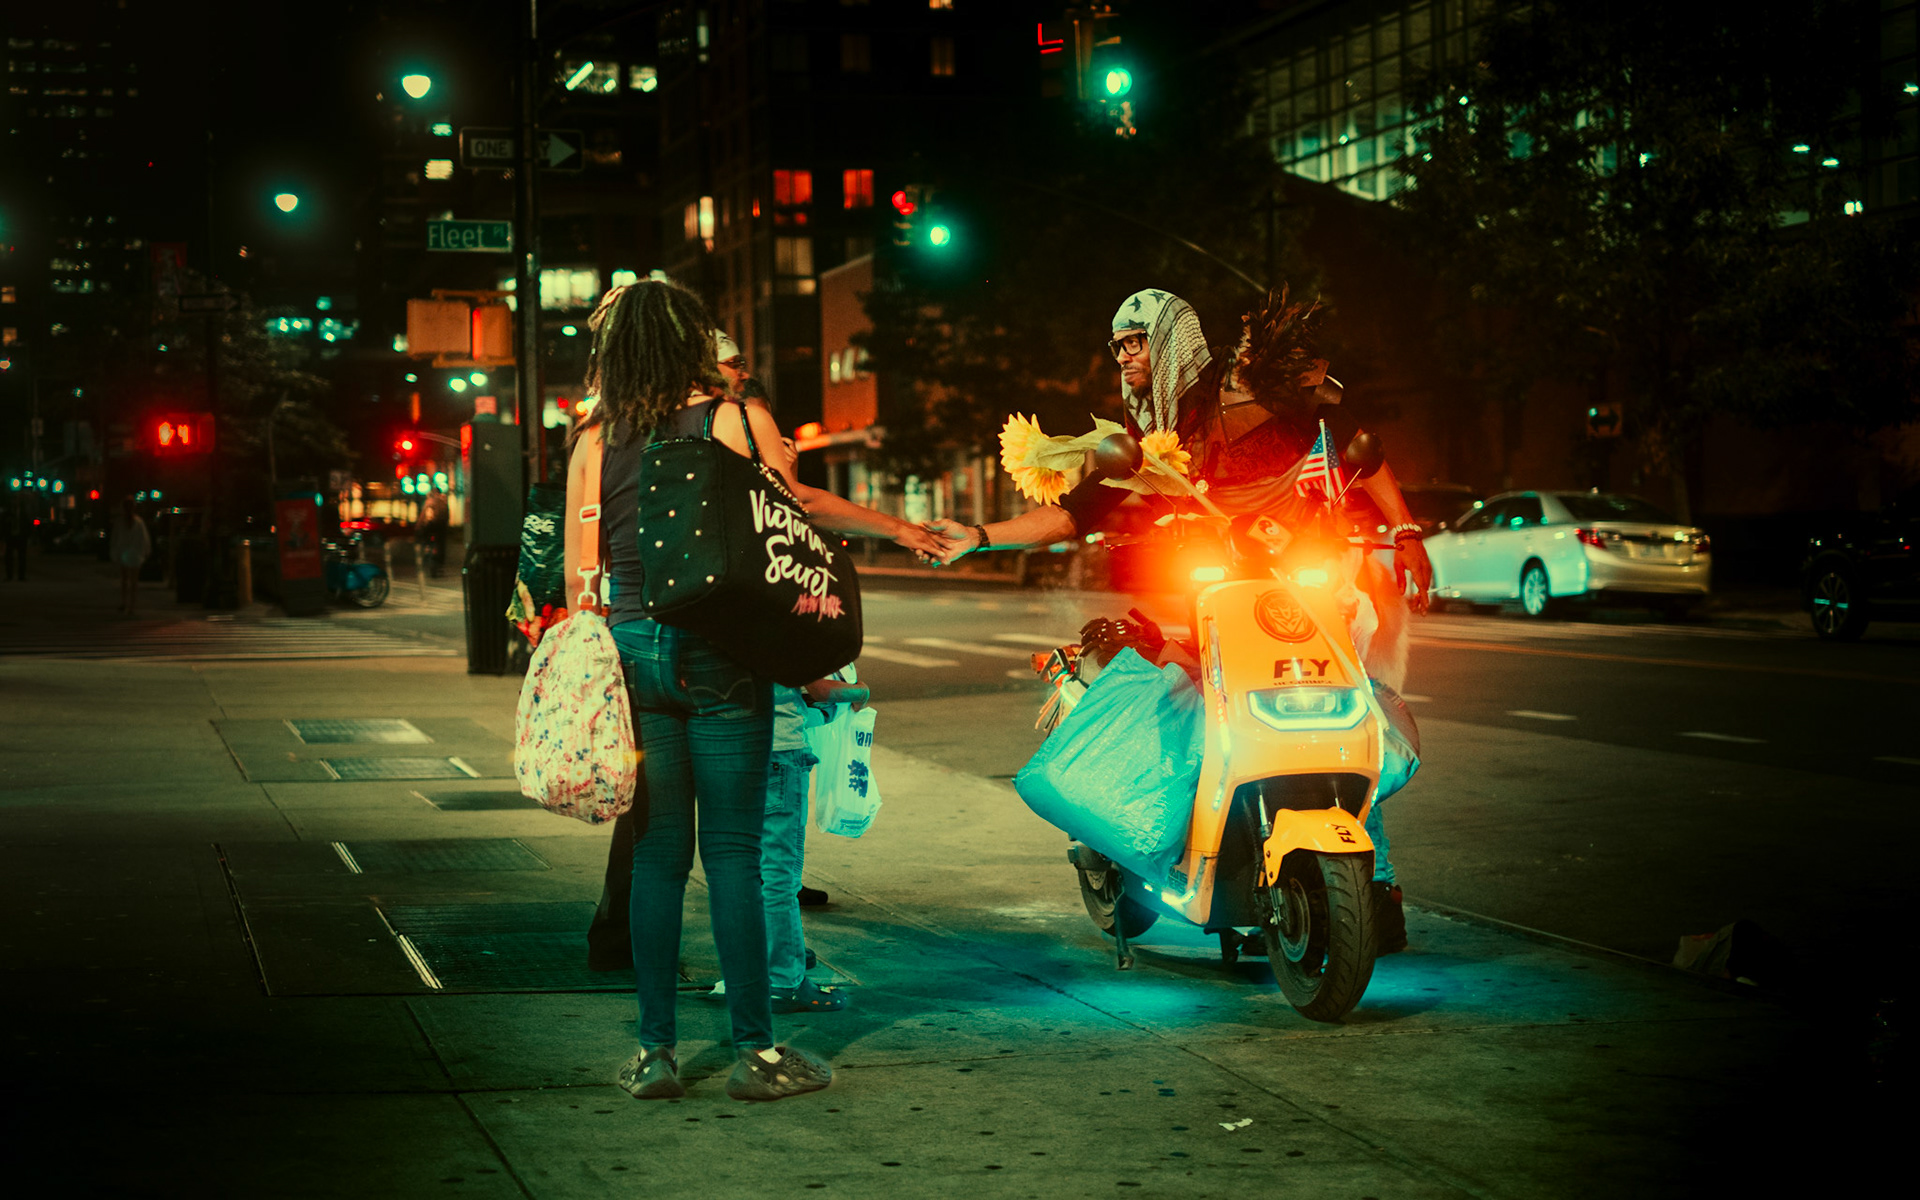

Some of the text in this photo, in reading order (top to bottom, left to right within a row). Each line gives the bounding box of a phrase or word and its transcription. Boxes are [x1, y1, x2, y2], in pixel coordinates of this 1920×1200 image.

[475, 140, 508, 157] ONE
[428, 224, 484, 248] Fleet
[765, 534, 839, 606] Secret
[1274, 658, 1330, 678] FLY
[1331, 823, 1357, 844] FLY
